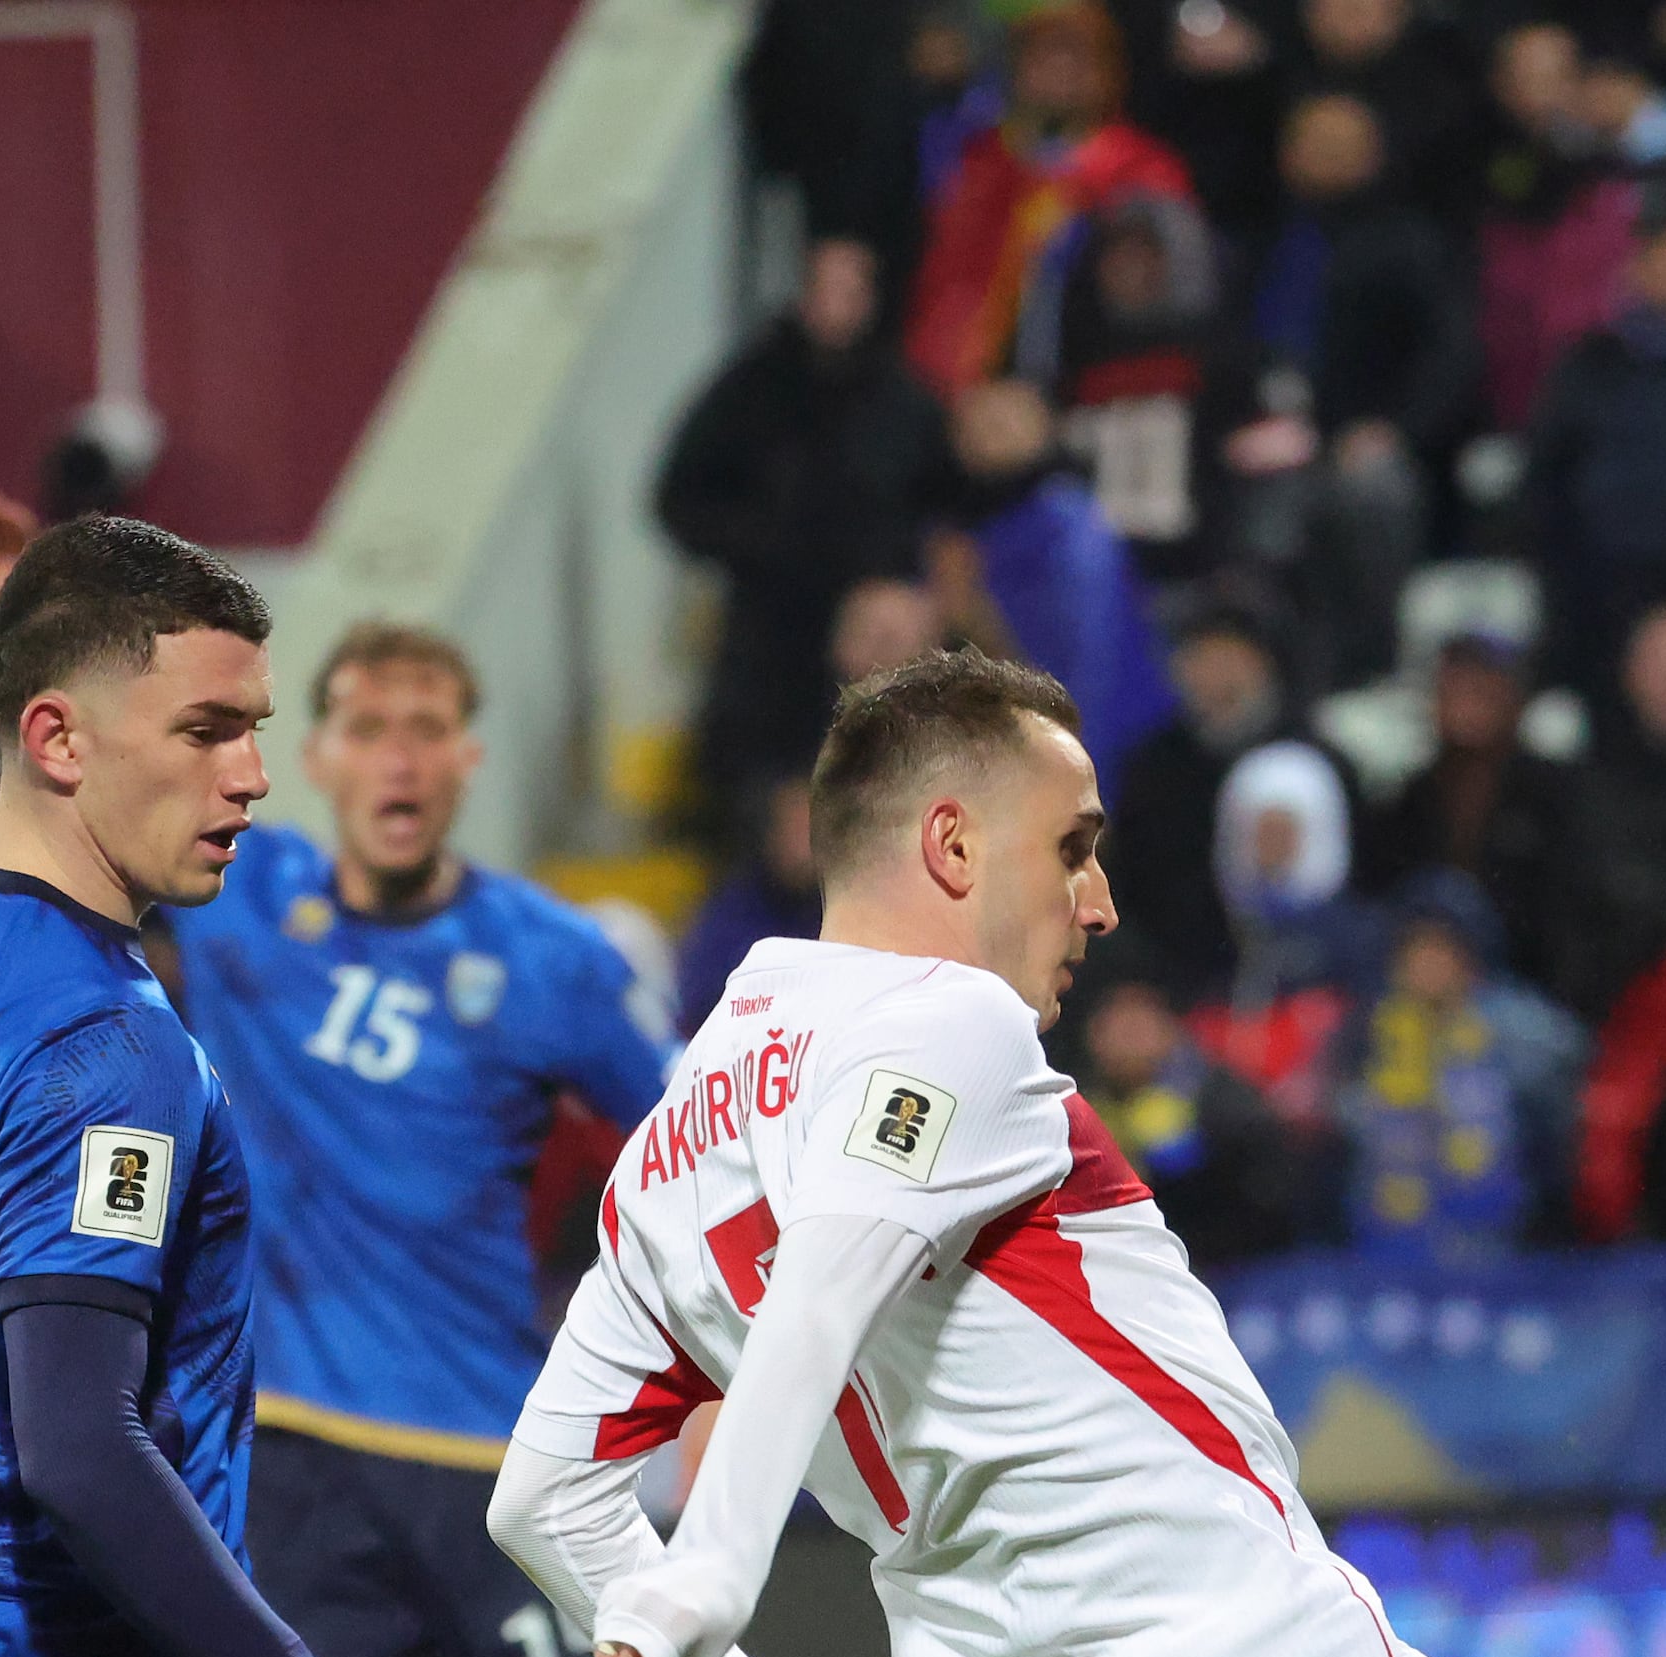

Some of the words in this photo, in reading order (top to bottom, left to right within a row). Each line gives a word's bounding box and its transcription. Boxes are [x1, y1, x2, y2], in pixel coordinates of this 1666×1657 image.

[730, 994, 774, 1017] TÜRKİYE
[305, 965, 432, 1082] 15
[103, 1210, 143, 1223] QUALIFIERS
